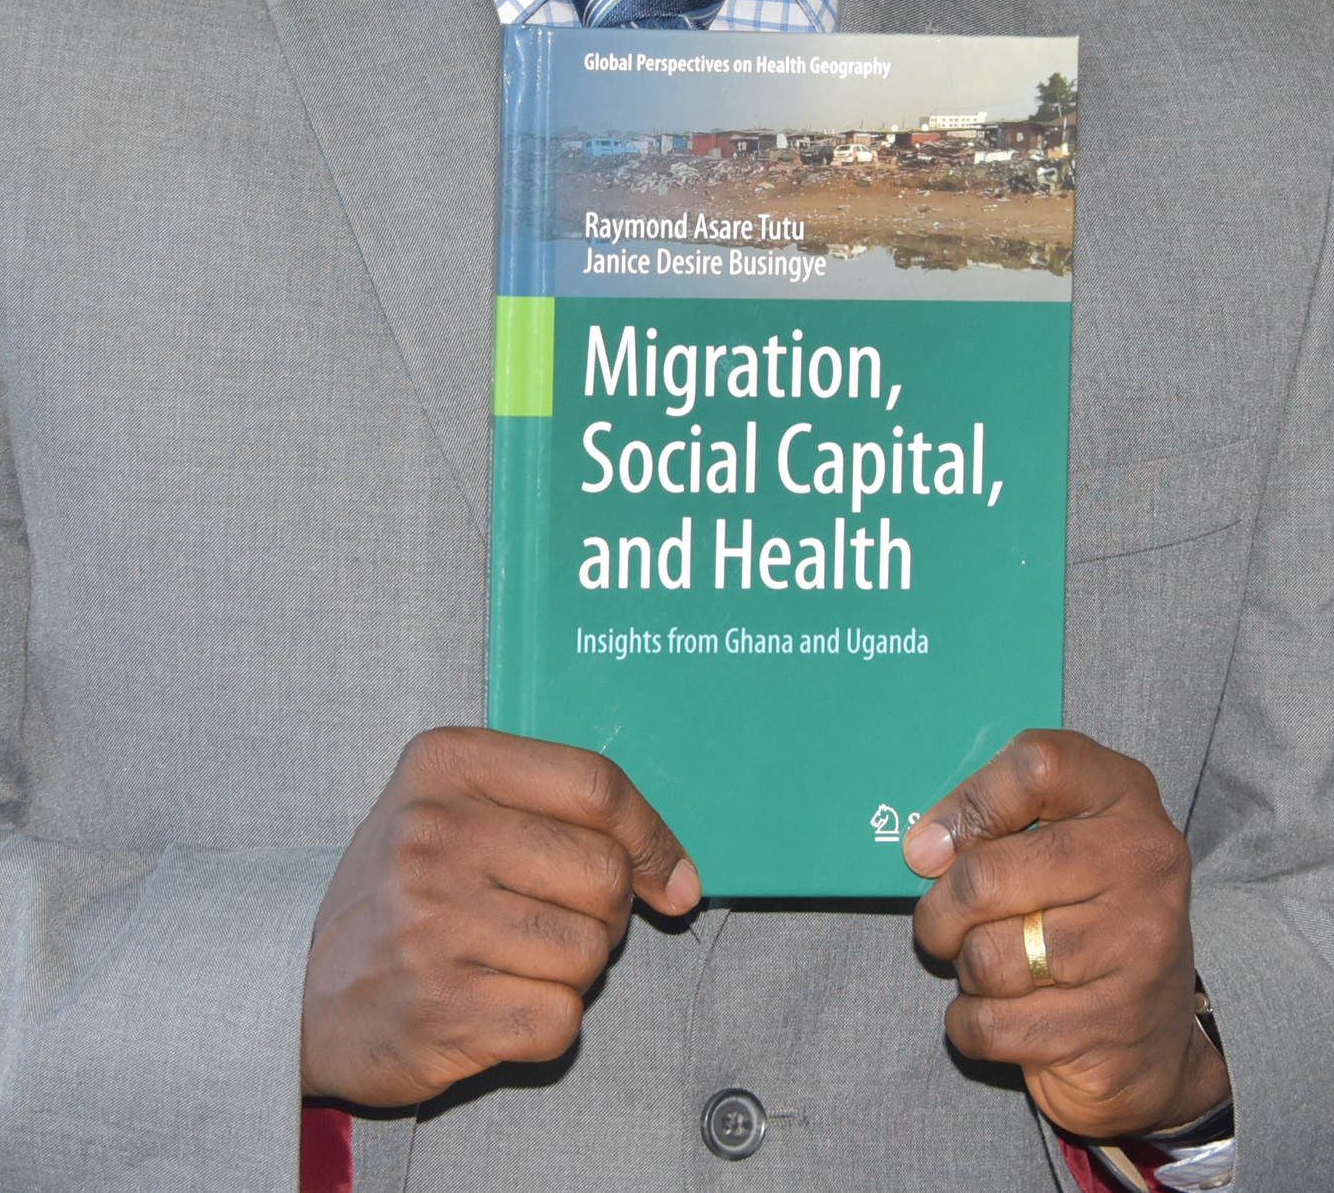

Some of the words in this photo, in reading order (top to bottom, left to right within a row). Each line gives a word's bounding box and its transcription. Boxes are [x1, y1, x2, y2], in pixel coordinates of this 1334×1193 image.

[583, 52, 633, 73] Global
[636, 53, 730, 78] Perspectives
[732, 57, 753, 74] on
[755, 55, 807, 74] Health
[809, 56, 892, 79] Geography
[584, 210, 688, 245] Raymond
[693, 212, 754, 240] Asare
[757, 213, 805, 241] Tutu
[582, 247, 652, 275] Janice
[656, 247, 723, 276] Desire
[729, 248, 827, 283] Busingye
[583, 324, 903, 418] Migration,
[580, 420, 758, 495] Social
[776, 421, 1004, 513] Capital,
[577, 516, 693, 590] and
[713, 517, 912, 590] Health
[576, 627, 662, 660] Insights
[667, 626, 719, 654] from
[724, 627, 794, 655] Ghana
[799, 627, 841, 655] and
[846, 627, 930, 660] Uganda
